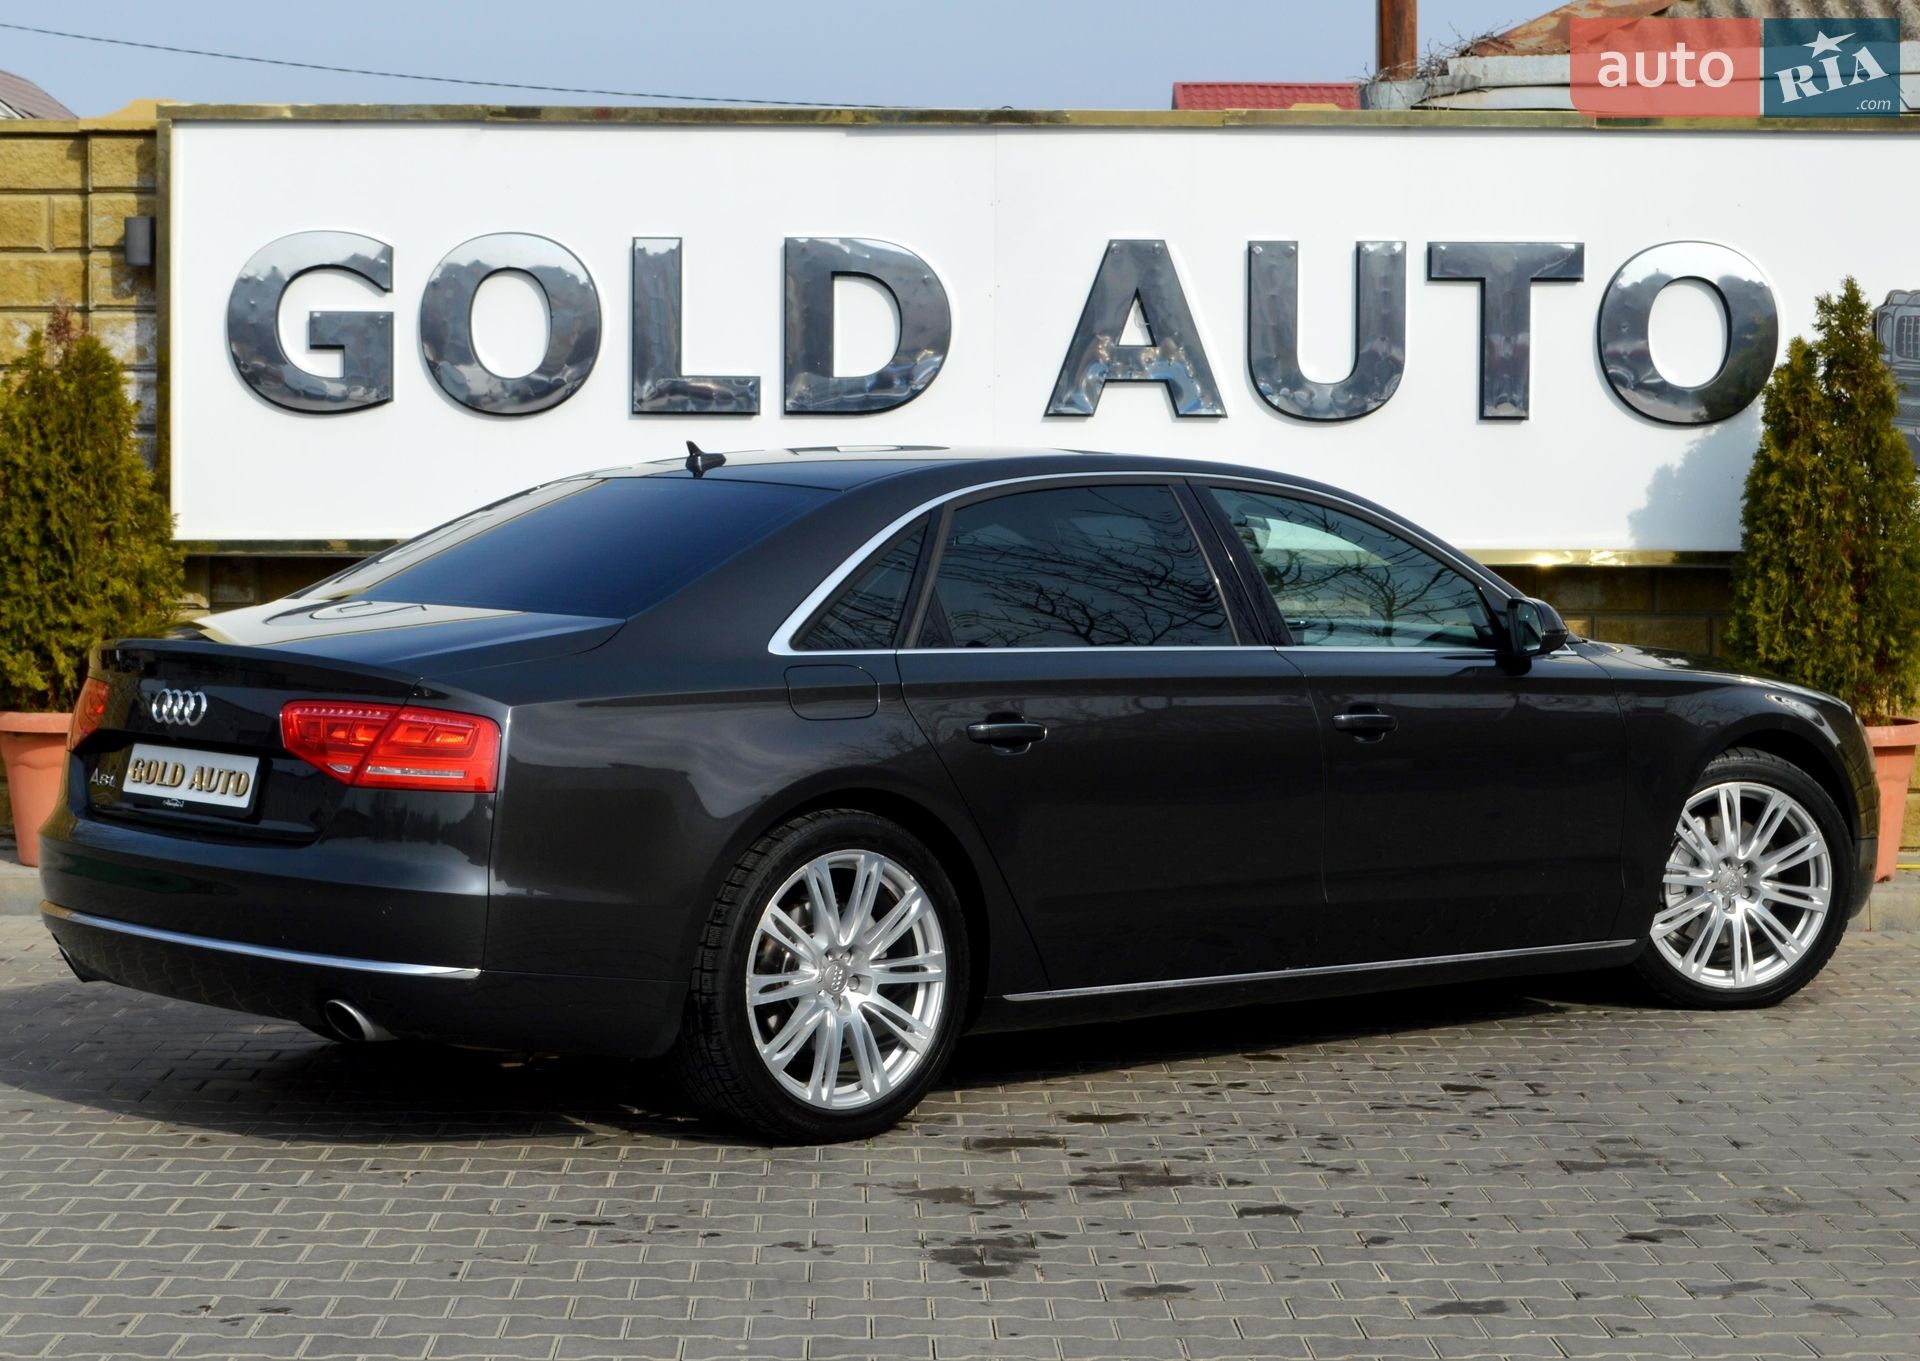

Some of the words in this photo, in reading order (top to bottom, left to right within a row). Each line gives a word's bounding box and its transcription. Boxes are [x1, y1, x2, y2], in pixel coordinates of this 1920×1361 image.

[226, 229, 951, 417] GOLD
[1043, 239, 1780, 424] AUTO
[127, 758, 185, 788] GOLD
[188, 766, 250, 797] AUTO
